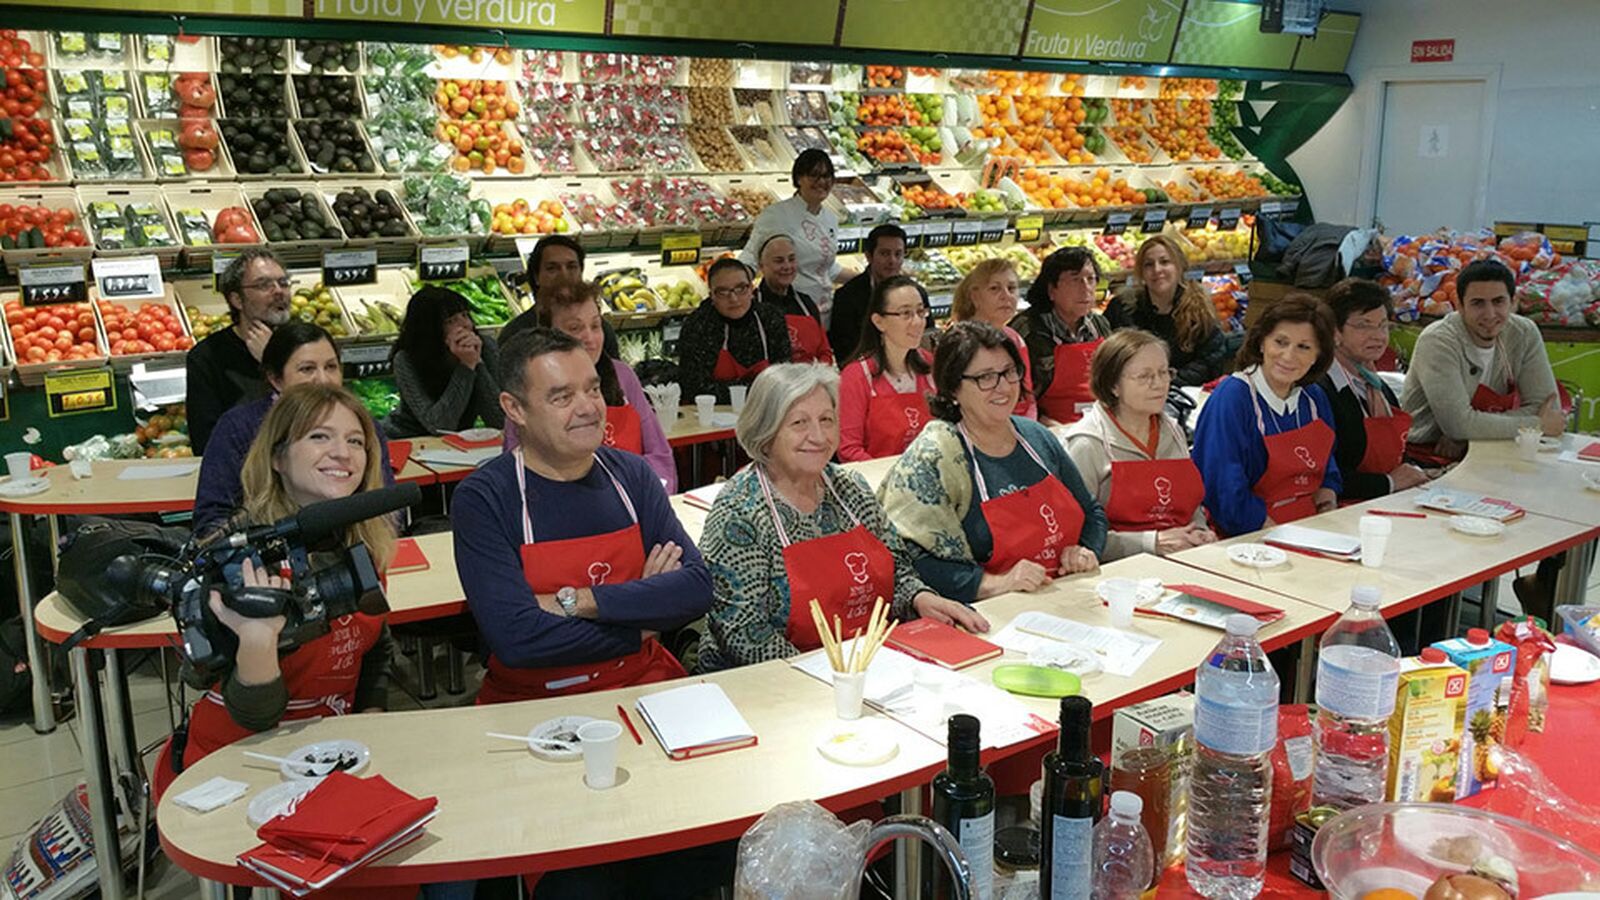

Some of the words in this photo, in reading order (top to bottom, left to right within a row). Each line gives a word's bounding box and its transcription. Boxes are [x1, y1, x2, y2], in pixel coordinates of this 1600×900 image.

[413, 0, 426, 22] y
[437, 0, 556, 26] Verdura
[1025, 29, 1070, 55] Fruta
[1072, 37, 1083, 58] y
[1086, 32, 1148, 59] Verdura
